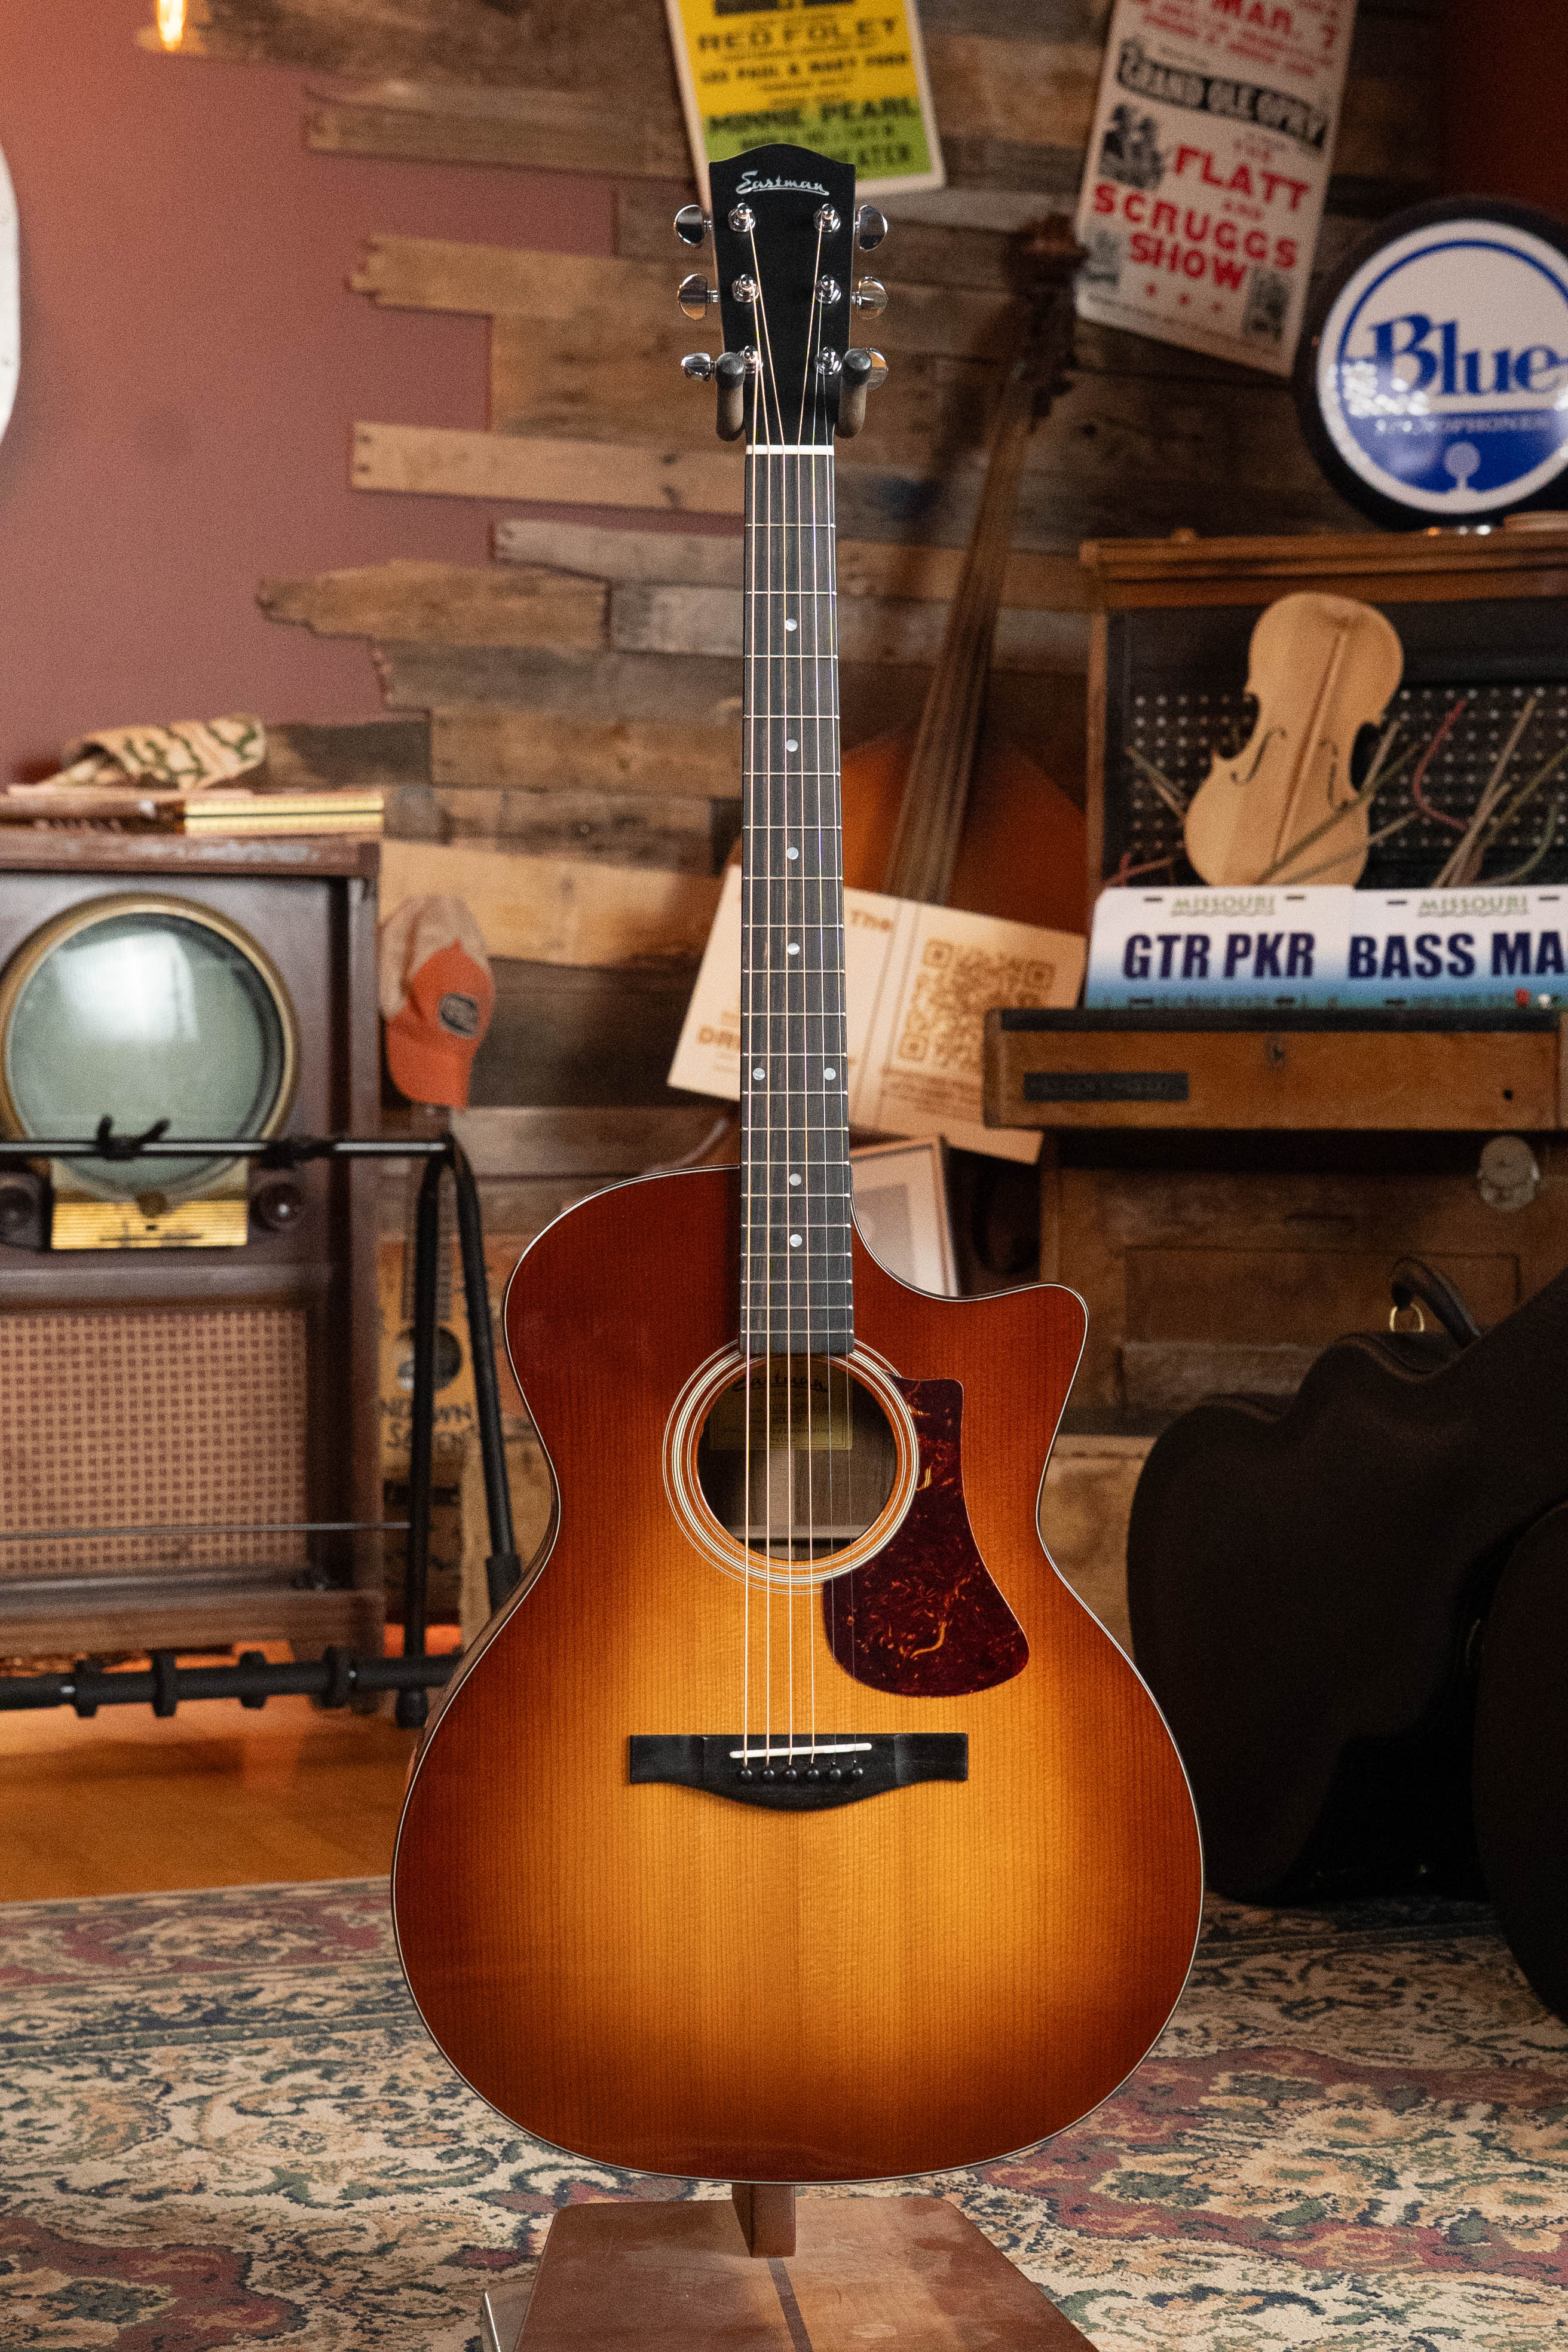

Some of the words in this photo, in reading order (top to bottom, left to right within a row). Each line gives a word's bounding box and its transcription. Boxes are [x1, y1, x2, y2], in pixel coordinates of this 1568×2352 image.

[736, 170, 830, 196] Eastman
[1174, 143, 1312, 212] FLATT
[1094, 182, 1299, 270] SCRUGGS
[1129, 231, 1248, 291] SHOW
[1369, 312, 1561, 396] Blue
[1171, 895, 1275, 910] MISSOURI
[1417, 894, 1529, 911] MISSOURI
[1122, 933, 1212, 979] GTR
[1223, 932, 1316, 979] PKR
[1348, 932, 1476, 979] BASS
